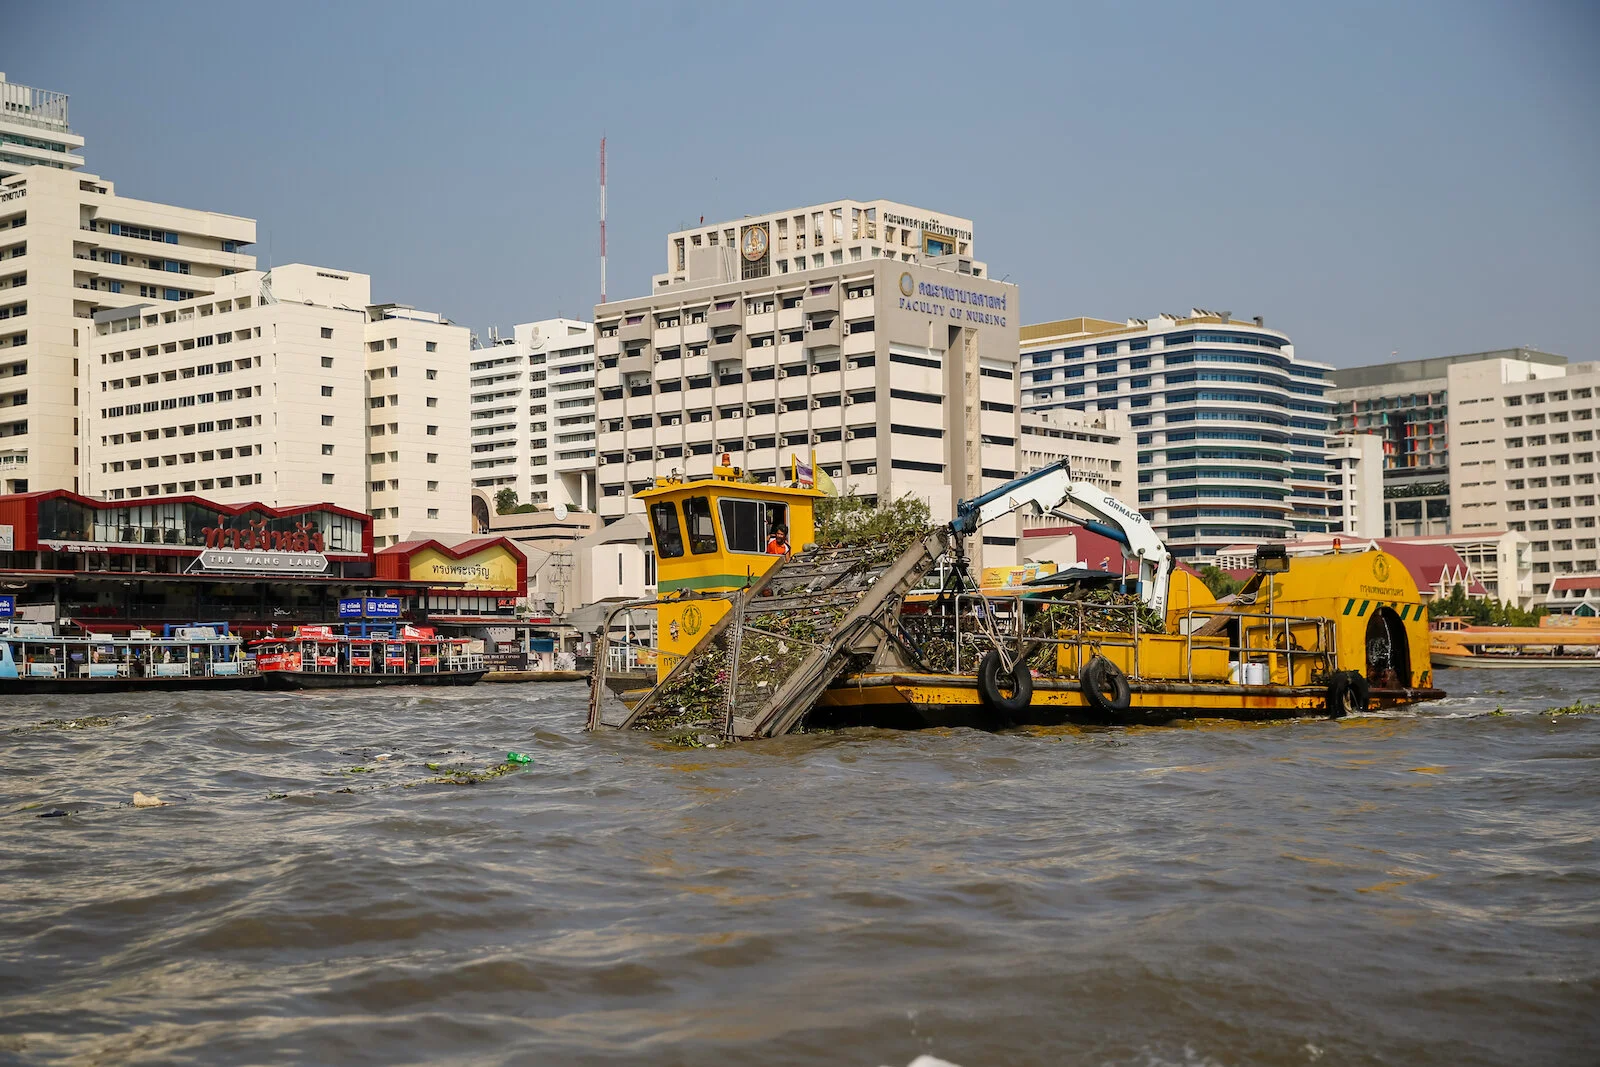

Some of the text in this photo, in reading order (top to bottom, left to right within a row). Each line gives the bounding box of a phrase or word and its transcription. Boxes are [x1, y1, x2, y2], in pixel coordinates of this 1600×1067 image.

[918, 281, 1007, 311] คณะพยาบาลศาสตร์
[899, 298, 1007, 328] FACULTY OF NURSING
[1103, 496, 1142, 524] CORMACH
[201, 514, 325, 554] ท่าวังหลัง
[209, 555, 321, 568] THA WANG LANG
[432, 563, 490, 580] ทรงพระเจริญ
